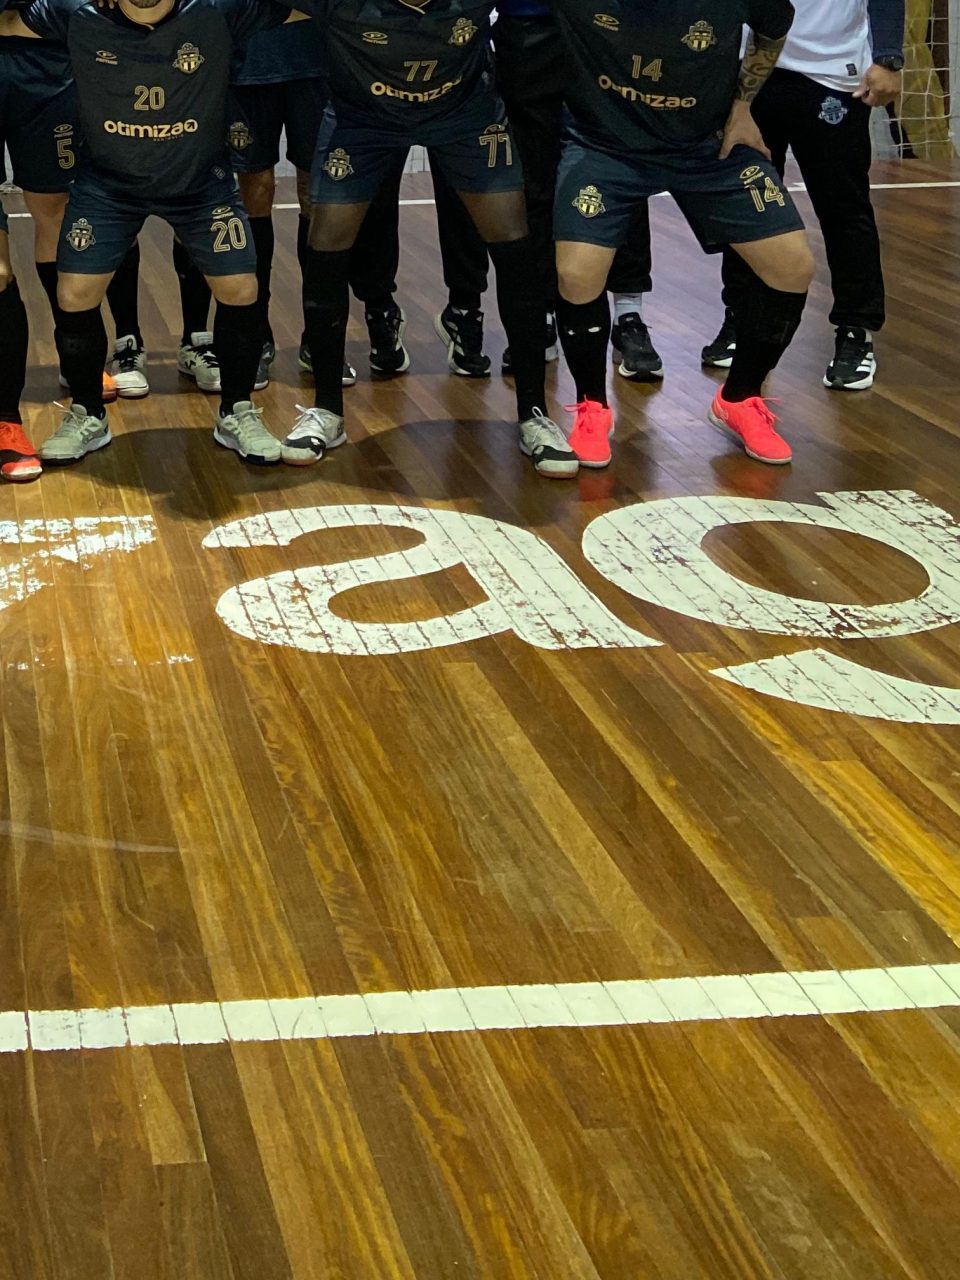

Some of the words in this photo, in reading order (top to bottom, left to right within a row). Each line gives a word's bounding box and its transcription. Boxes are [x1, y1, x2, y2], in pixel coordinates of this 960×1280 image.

[404, 60, 438, 82] 77
[632, 54, 663, 82] 14
[133, 85, 165, 111] 20
[57, 138, 75, 170] 5
[479, 133, 512, 167] 77
[744, 177, 786, 212] 14
[210, 217, 247, 253] 20
